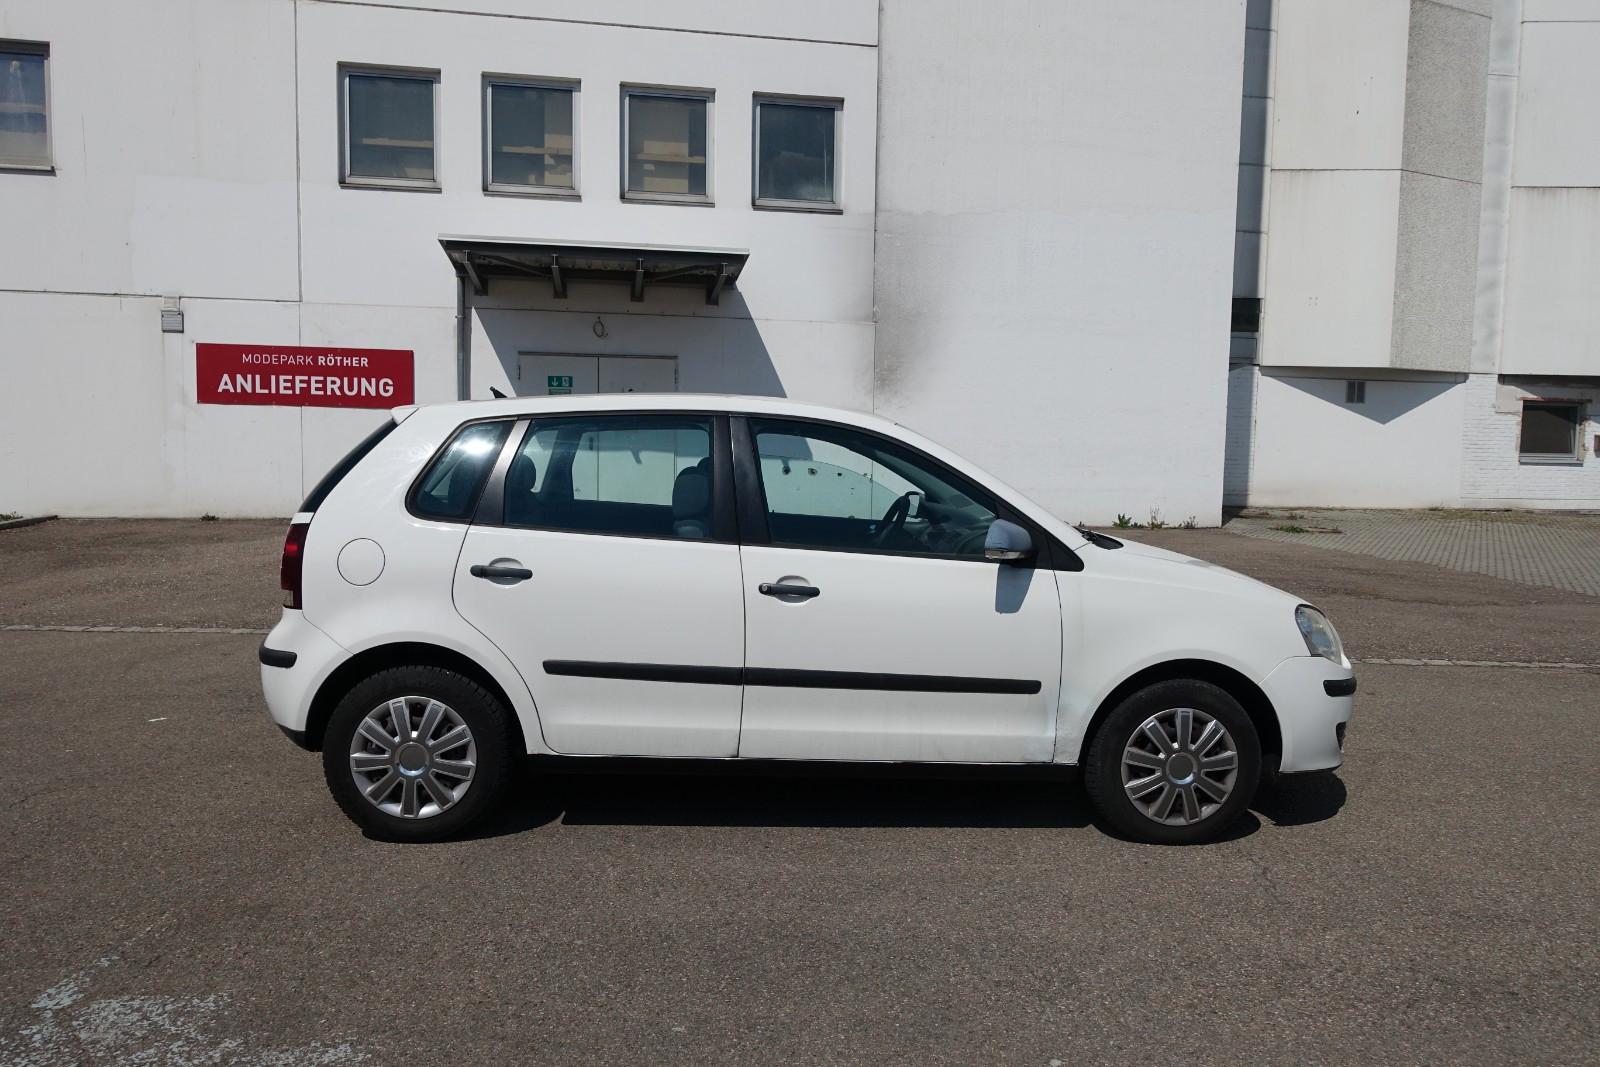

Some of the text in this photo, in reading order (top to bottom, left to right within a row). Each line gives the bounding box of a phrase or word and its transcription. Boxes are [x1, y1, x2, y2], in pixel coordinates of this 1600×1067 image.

[242, 353, 369, 367] MODEPARK RÖTHER
[217, 373, 394, 397] ANLIEFERUNG
